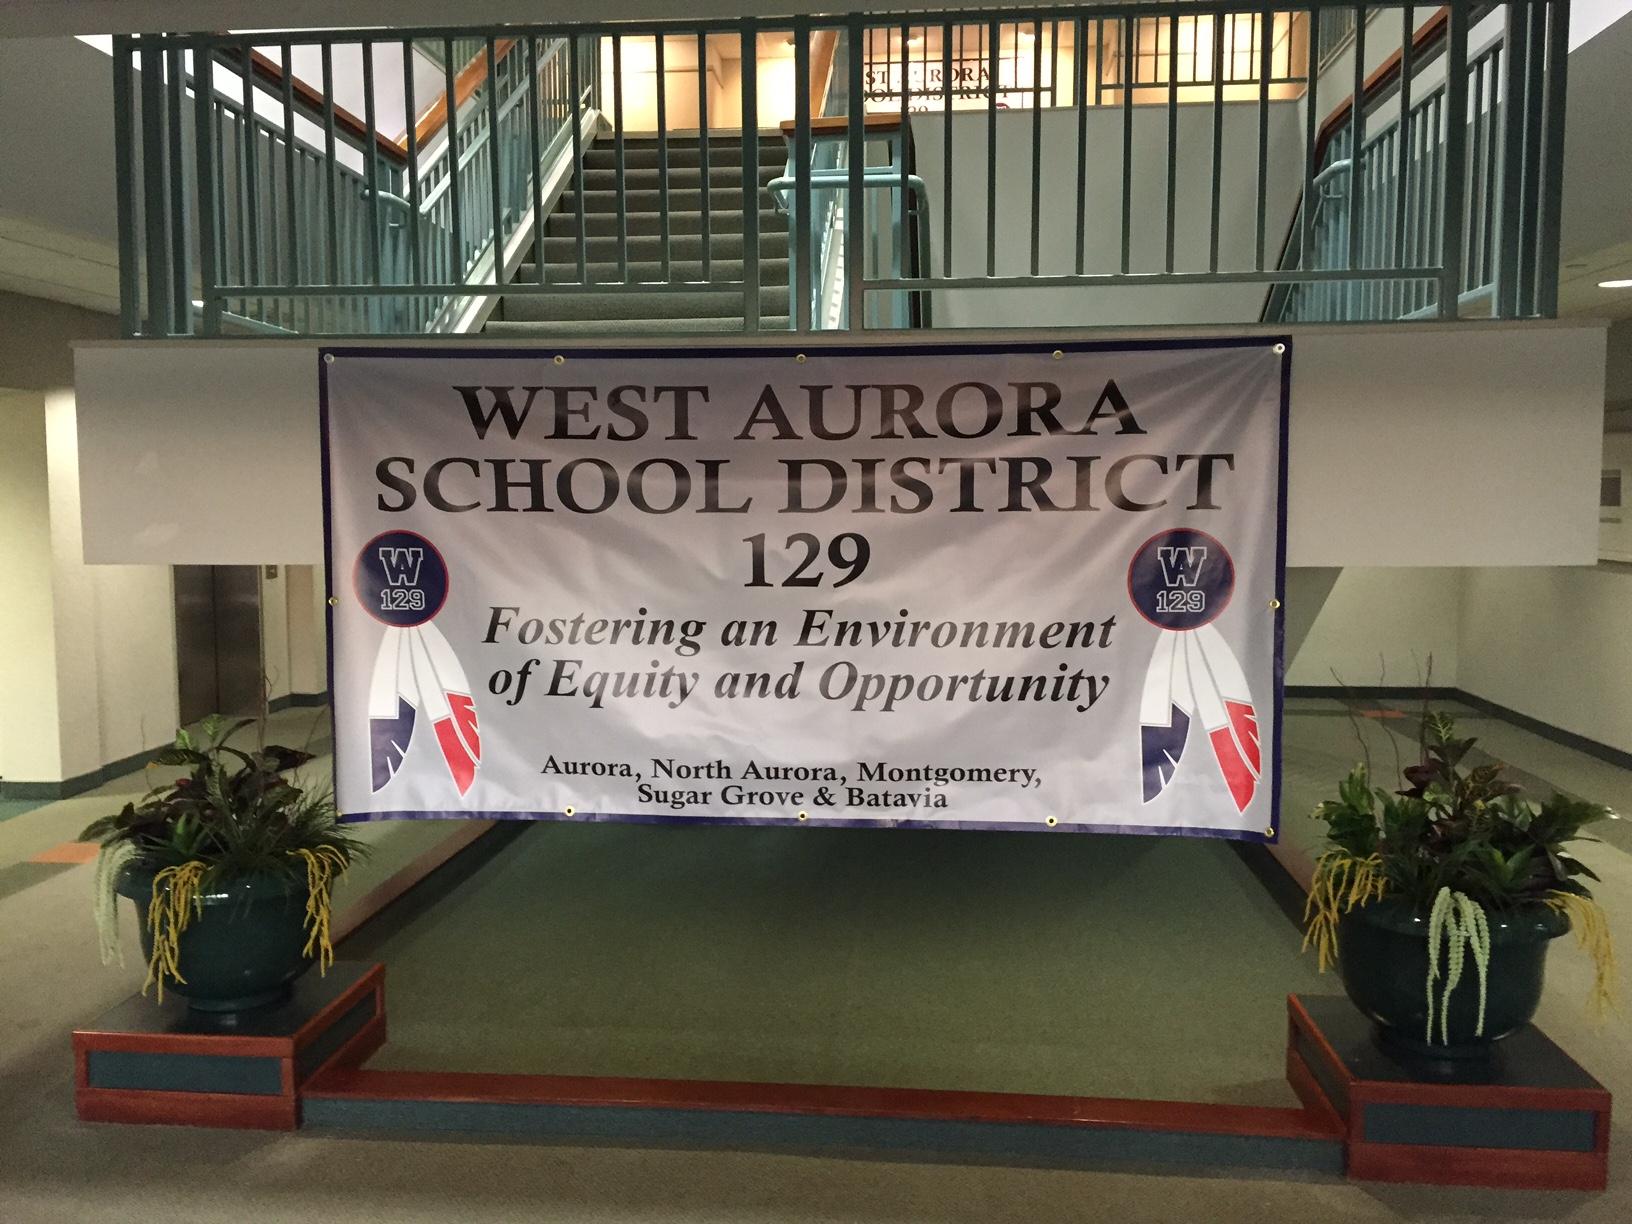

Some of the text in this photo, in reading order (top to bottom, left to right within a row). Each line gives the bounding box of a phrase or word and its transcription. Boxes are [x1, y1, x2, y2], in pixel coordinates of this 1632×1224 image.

[452, 378, 1147, 442] WEST AURORA
[375, 453, 1235, 514] SCHOOL DISTRICT
[743, 531, 871, 589] 129
[380, 588, 426, 611] 129
[1155, 590, 1206, 613] 129
[481, 606, 1117, 657] Fostering an Environment
[488, 658, 1111, 713] of Equity and Opportunity
[541, 754, 1043, 789] Aurora, North Aurora, Montgomery,
[637, 783, 949, 809] Sugar Grove & Batavia
